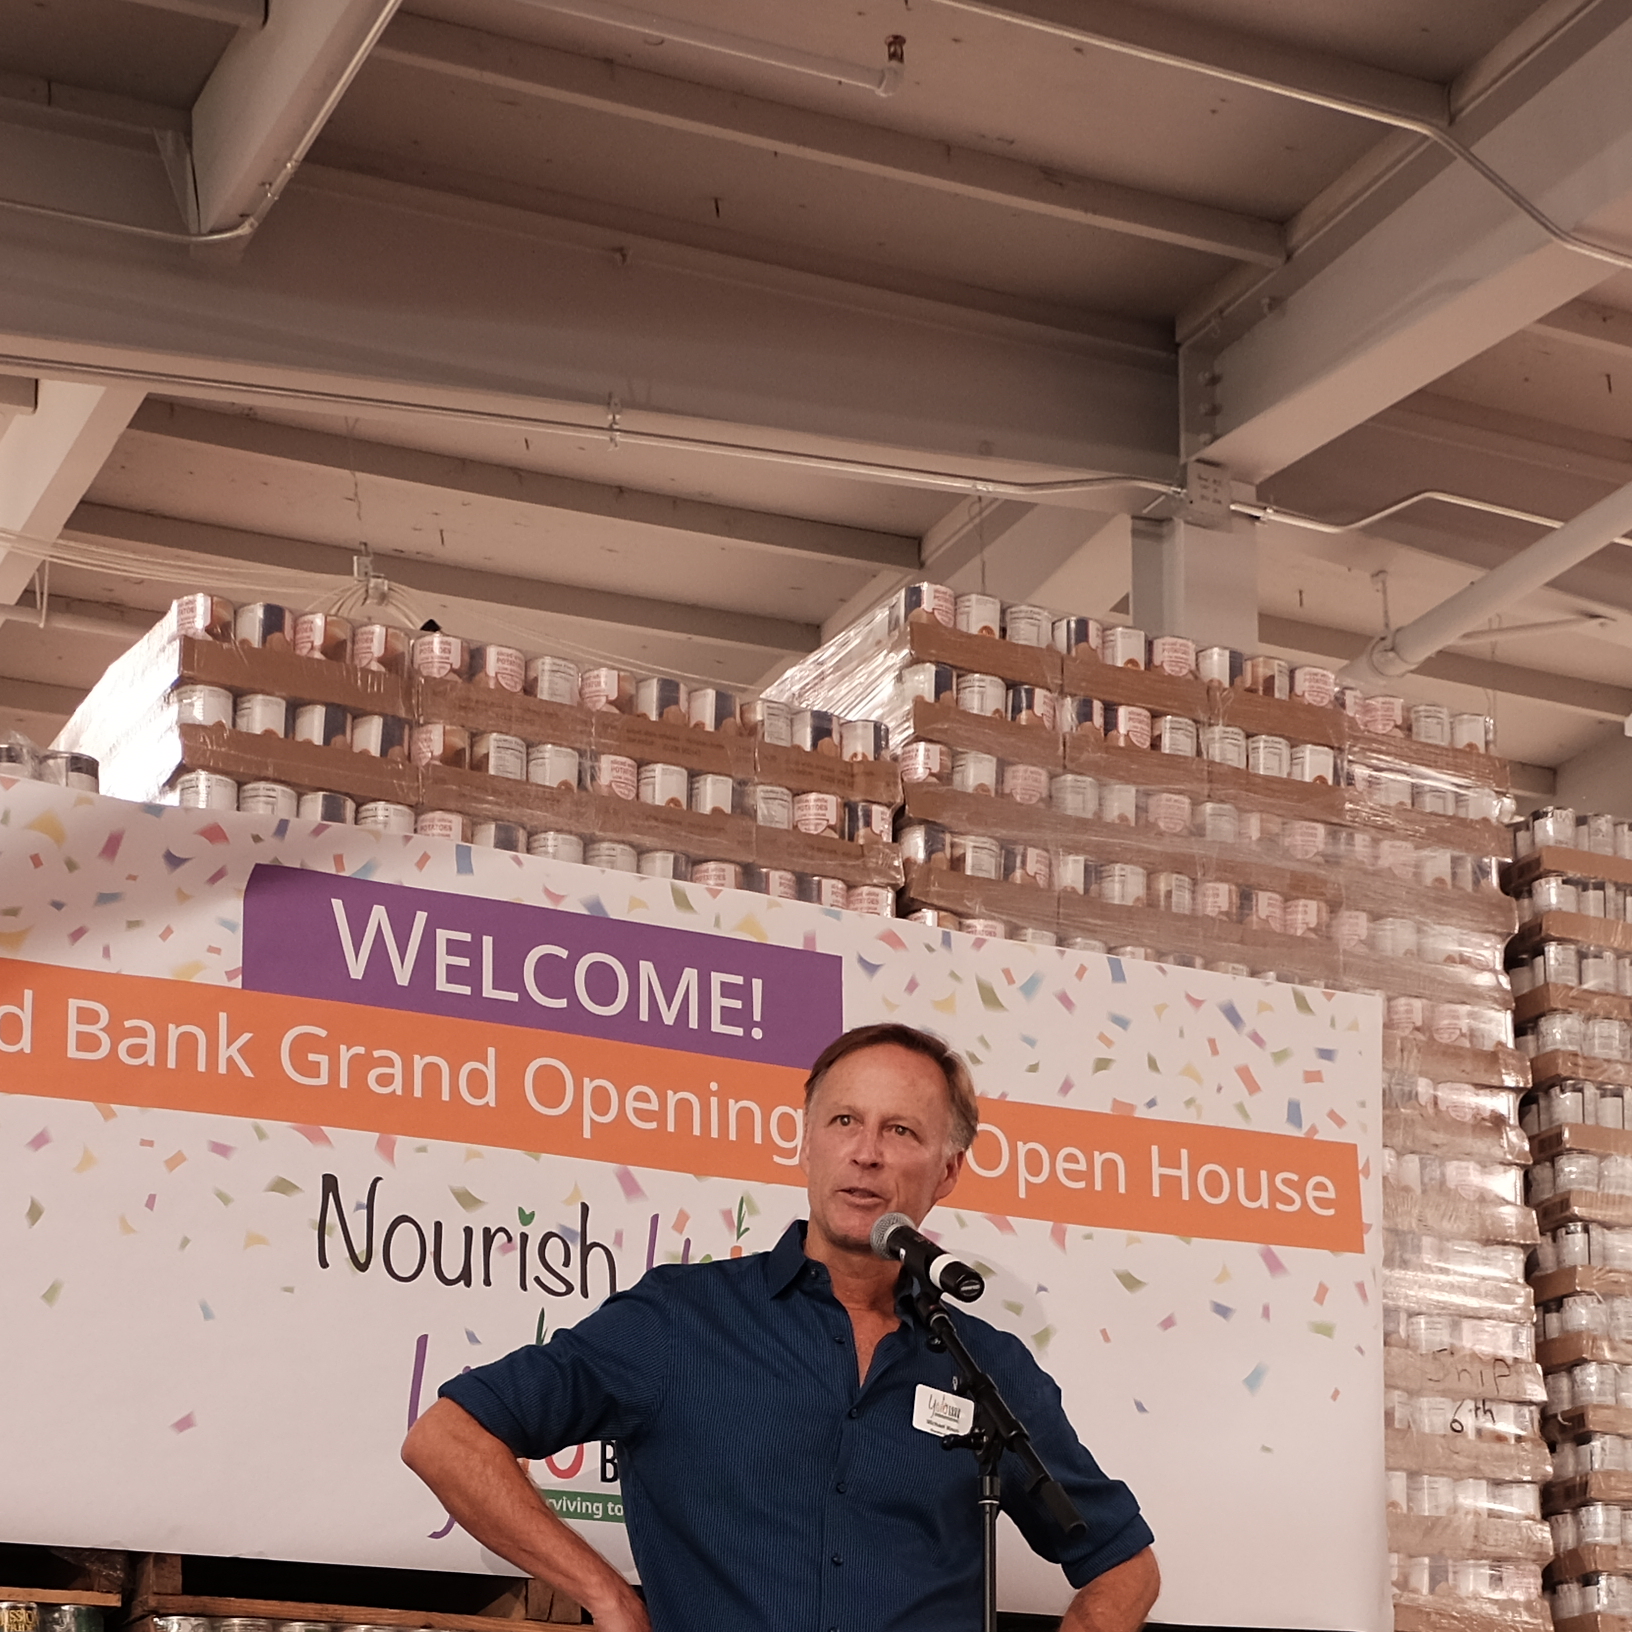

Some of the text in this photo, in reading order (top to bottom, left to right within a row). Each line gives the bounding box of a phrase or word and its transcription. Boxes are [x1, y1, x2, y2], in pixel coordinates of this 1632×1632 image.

[419, 823, 453, 833] POTATOES
[331, 898, 763, 1040] WELCOME!
[68, 998, 254, 1078] Bank
[280, 1025, 496, 1107] Grand
[524, 1057, 803, 1165] Opening
[967, 1122, 1126, 1199] Open
[1151, 1145, 1336, 1216] House
[318, 1173, 617, 1299] Nourish
